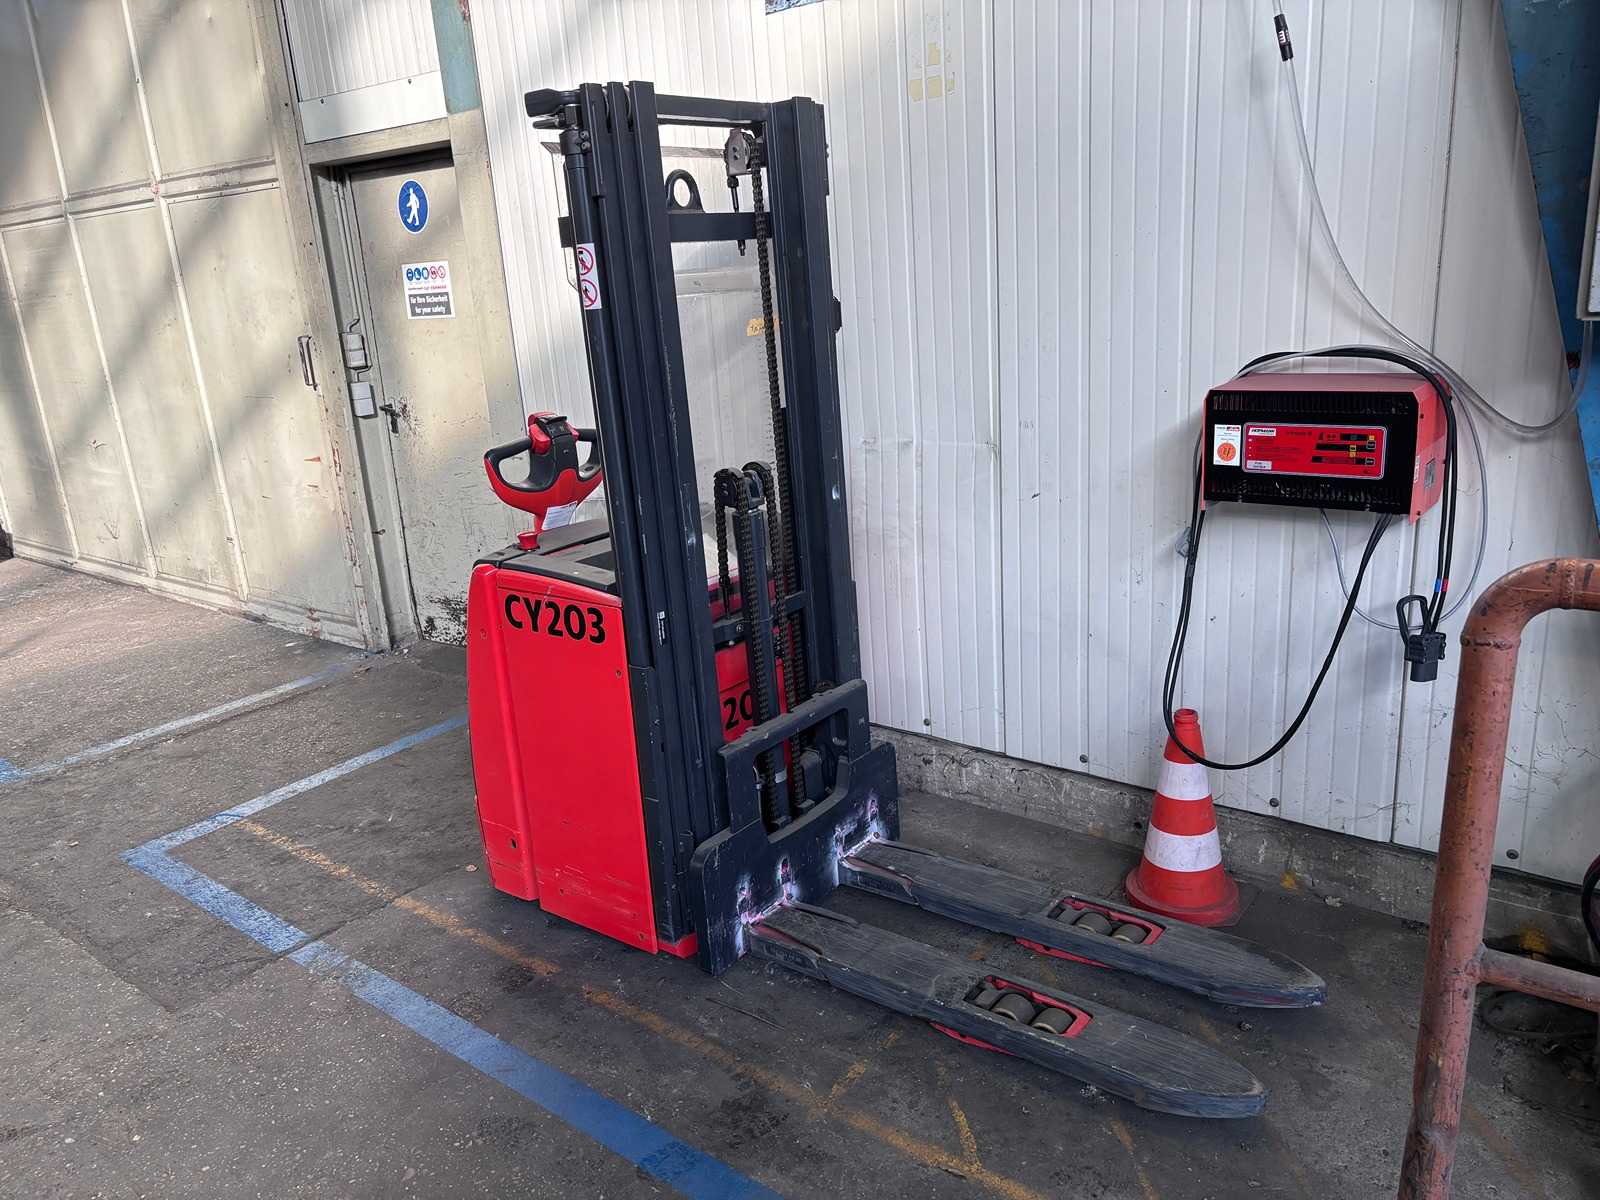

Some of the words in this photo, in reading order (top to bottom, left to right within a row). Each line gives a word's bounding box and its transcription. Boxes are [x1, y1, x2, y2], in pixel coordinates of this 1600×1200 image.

[426, 295, 448, 303] Sicherheit
[432, 305, 446, 314] safety
[505, 594, 606, 643] CY203
